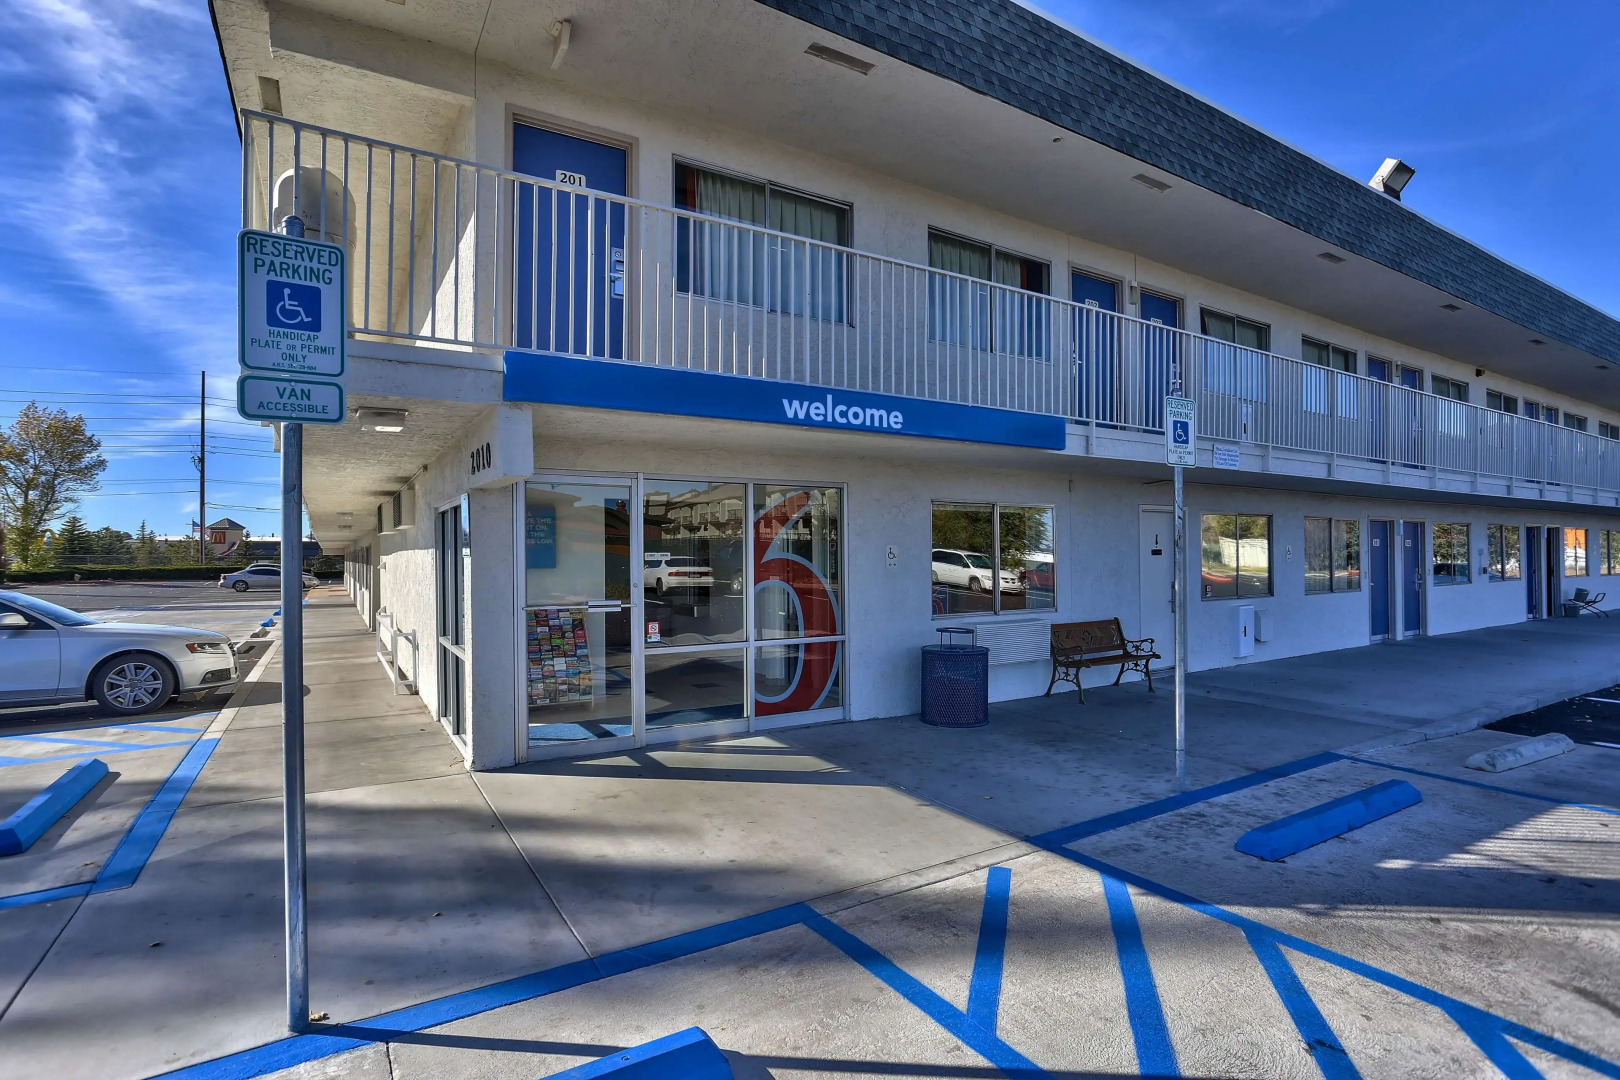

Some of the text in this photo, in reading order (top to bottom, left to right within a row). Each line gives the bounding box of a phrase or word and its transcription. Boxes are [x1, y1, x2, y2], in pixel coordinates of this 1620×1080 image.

[560, 172, 582, 186] 201
[246, 235, 339, 268] RESERVED
[253, 257, 333, 286] PARKING
[268, 328, 319, 343] HANDICAP
[250, 337, 336, 356] PLATE OR PERMIT
[281, 352, 307, 363] ONLY
[276, 386, 311, 401] VAN
[257, 401, 329, 415] ACCESSIBLE
[782, 394, 904, 429] welcome
[1167, 399, 1193, 411] RESERVED
[1169, 409, 1193, 420] PARKING
[470, 442, 492, 476] 2010
